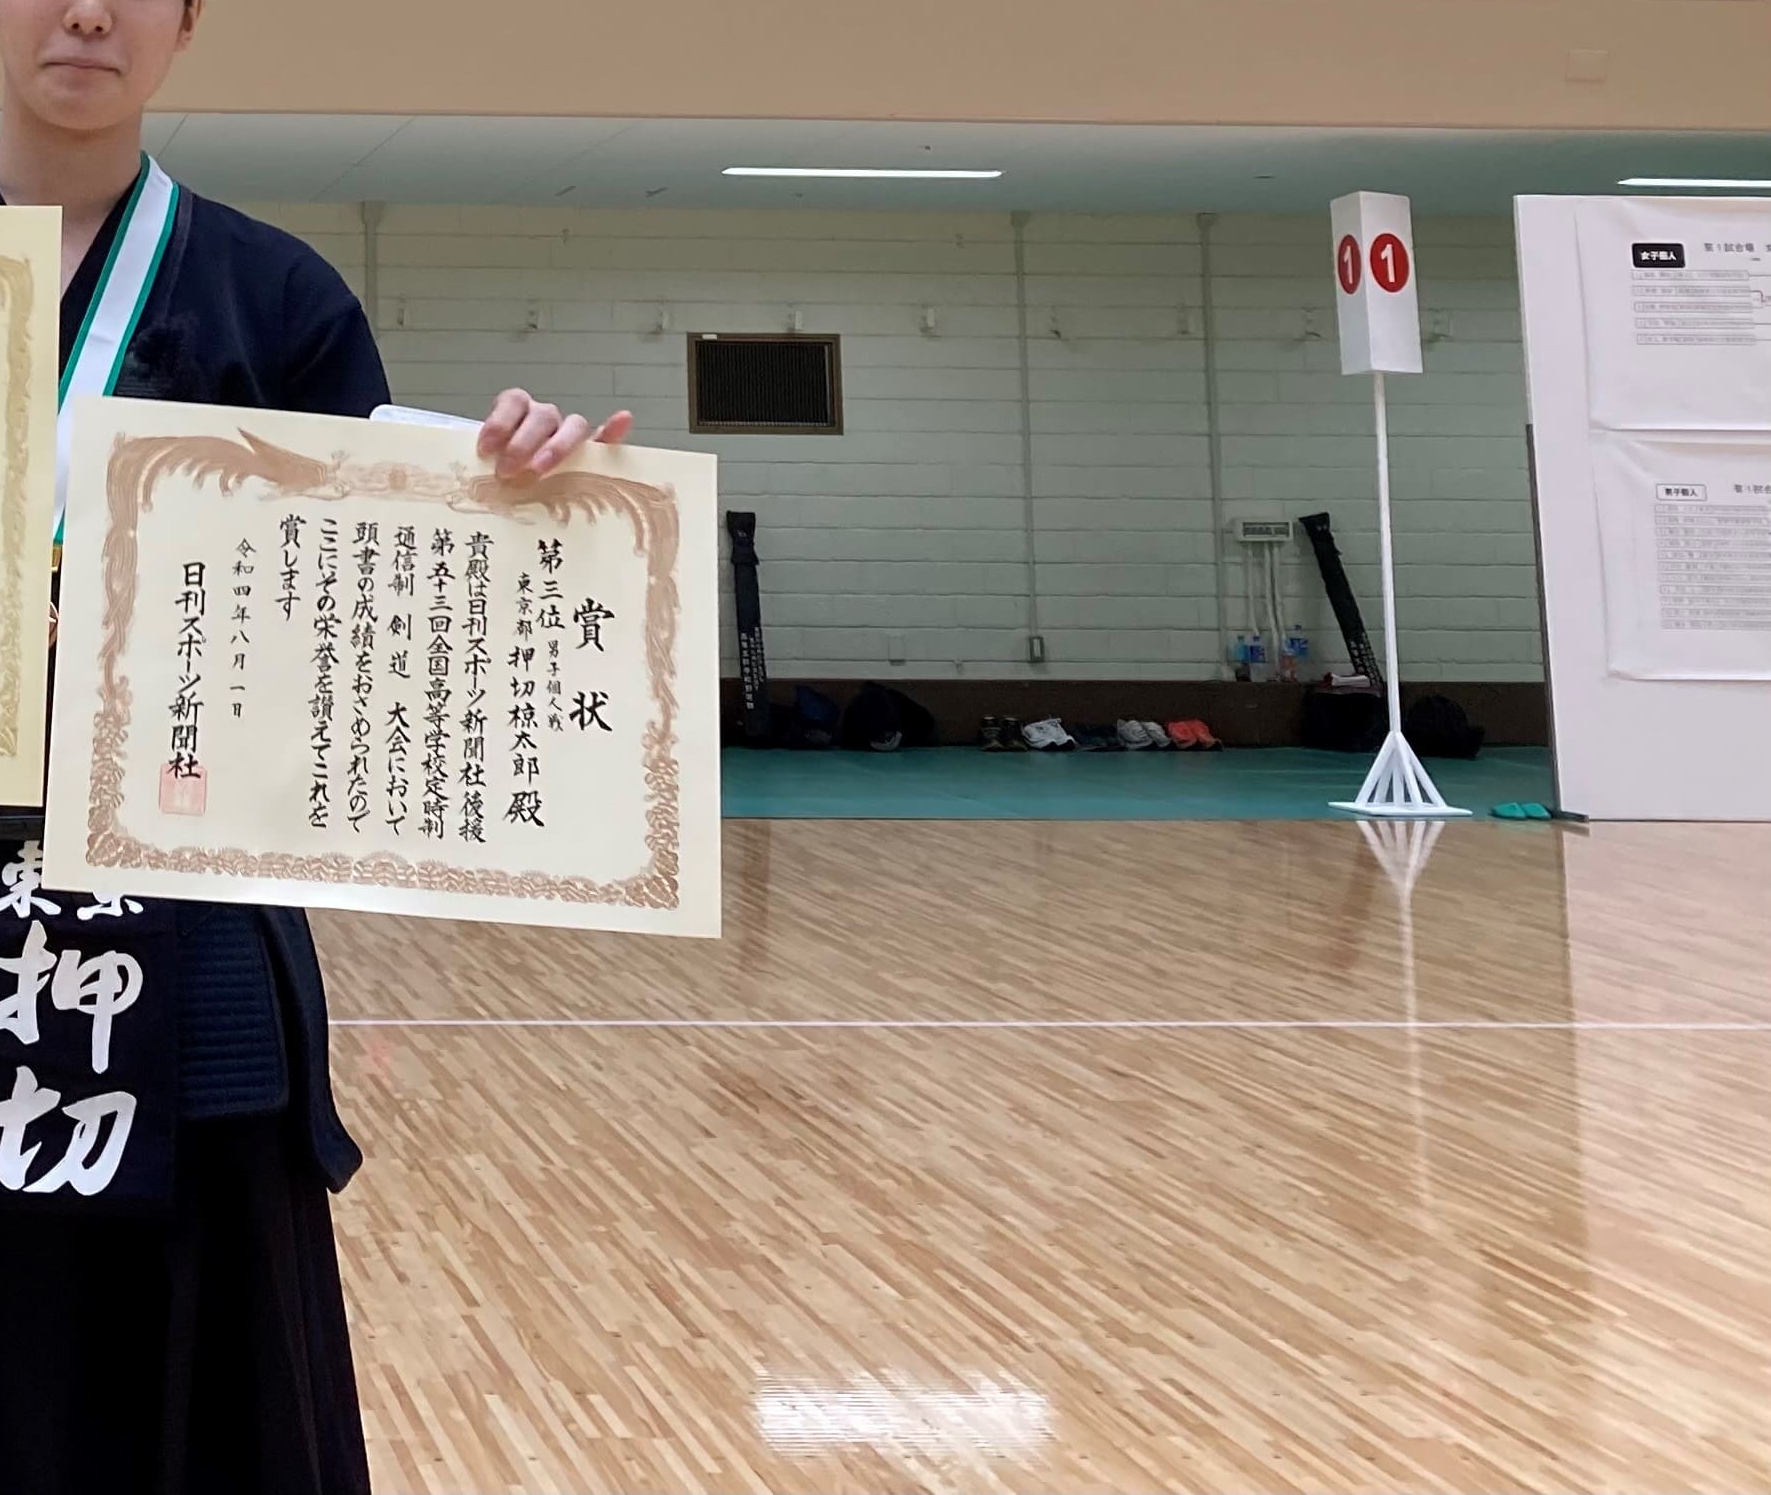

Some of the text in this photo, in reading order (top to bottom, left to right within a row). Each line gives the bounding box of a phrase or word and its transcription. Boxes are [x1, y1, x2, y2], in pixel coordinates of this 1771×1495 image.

[1343, 246, 1355, 285] 1
[1381, 244, 1398, 283] 1
[229, 537, 257, 718] 令和四年八月一日
[275, 513, 306, 622] 賞します
[513, 571, 535, 642] 東京都
[536, 537, 565, 733] 第三位 男子個人戦
[167, 561, 207, 780] 日刊スポーツ新聞社
[347, 521, 381, 834] 頭書の成績をおさめられたので
[384, 525, 417, 837] 通信制 剣道 大会において
[417, 527, 456, 840] 第五十三回全国高等学校定時制
[458, 530, 495, 844] 貴殿は日刊スポーツ新聞社後援
[568, 596, 616, 733] 賞状
